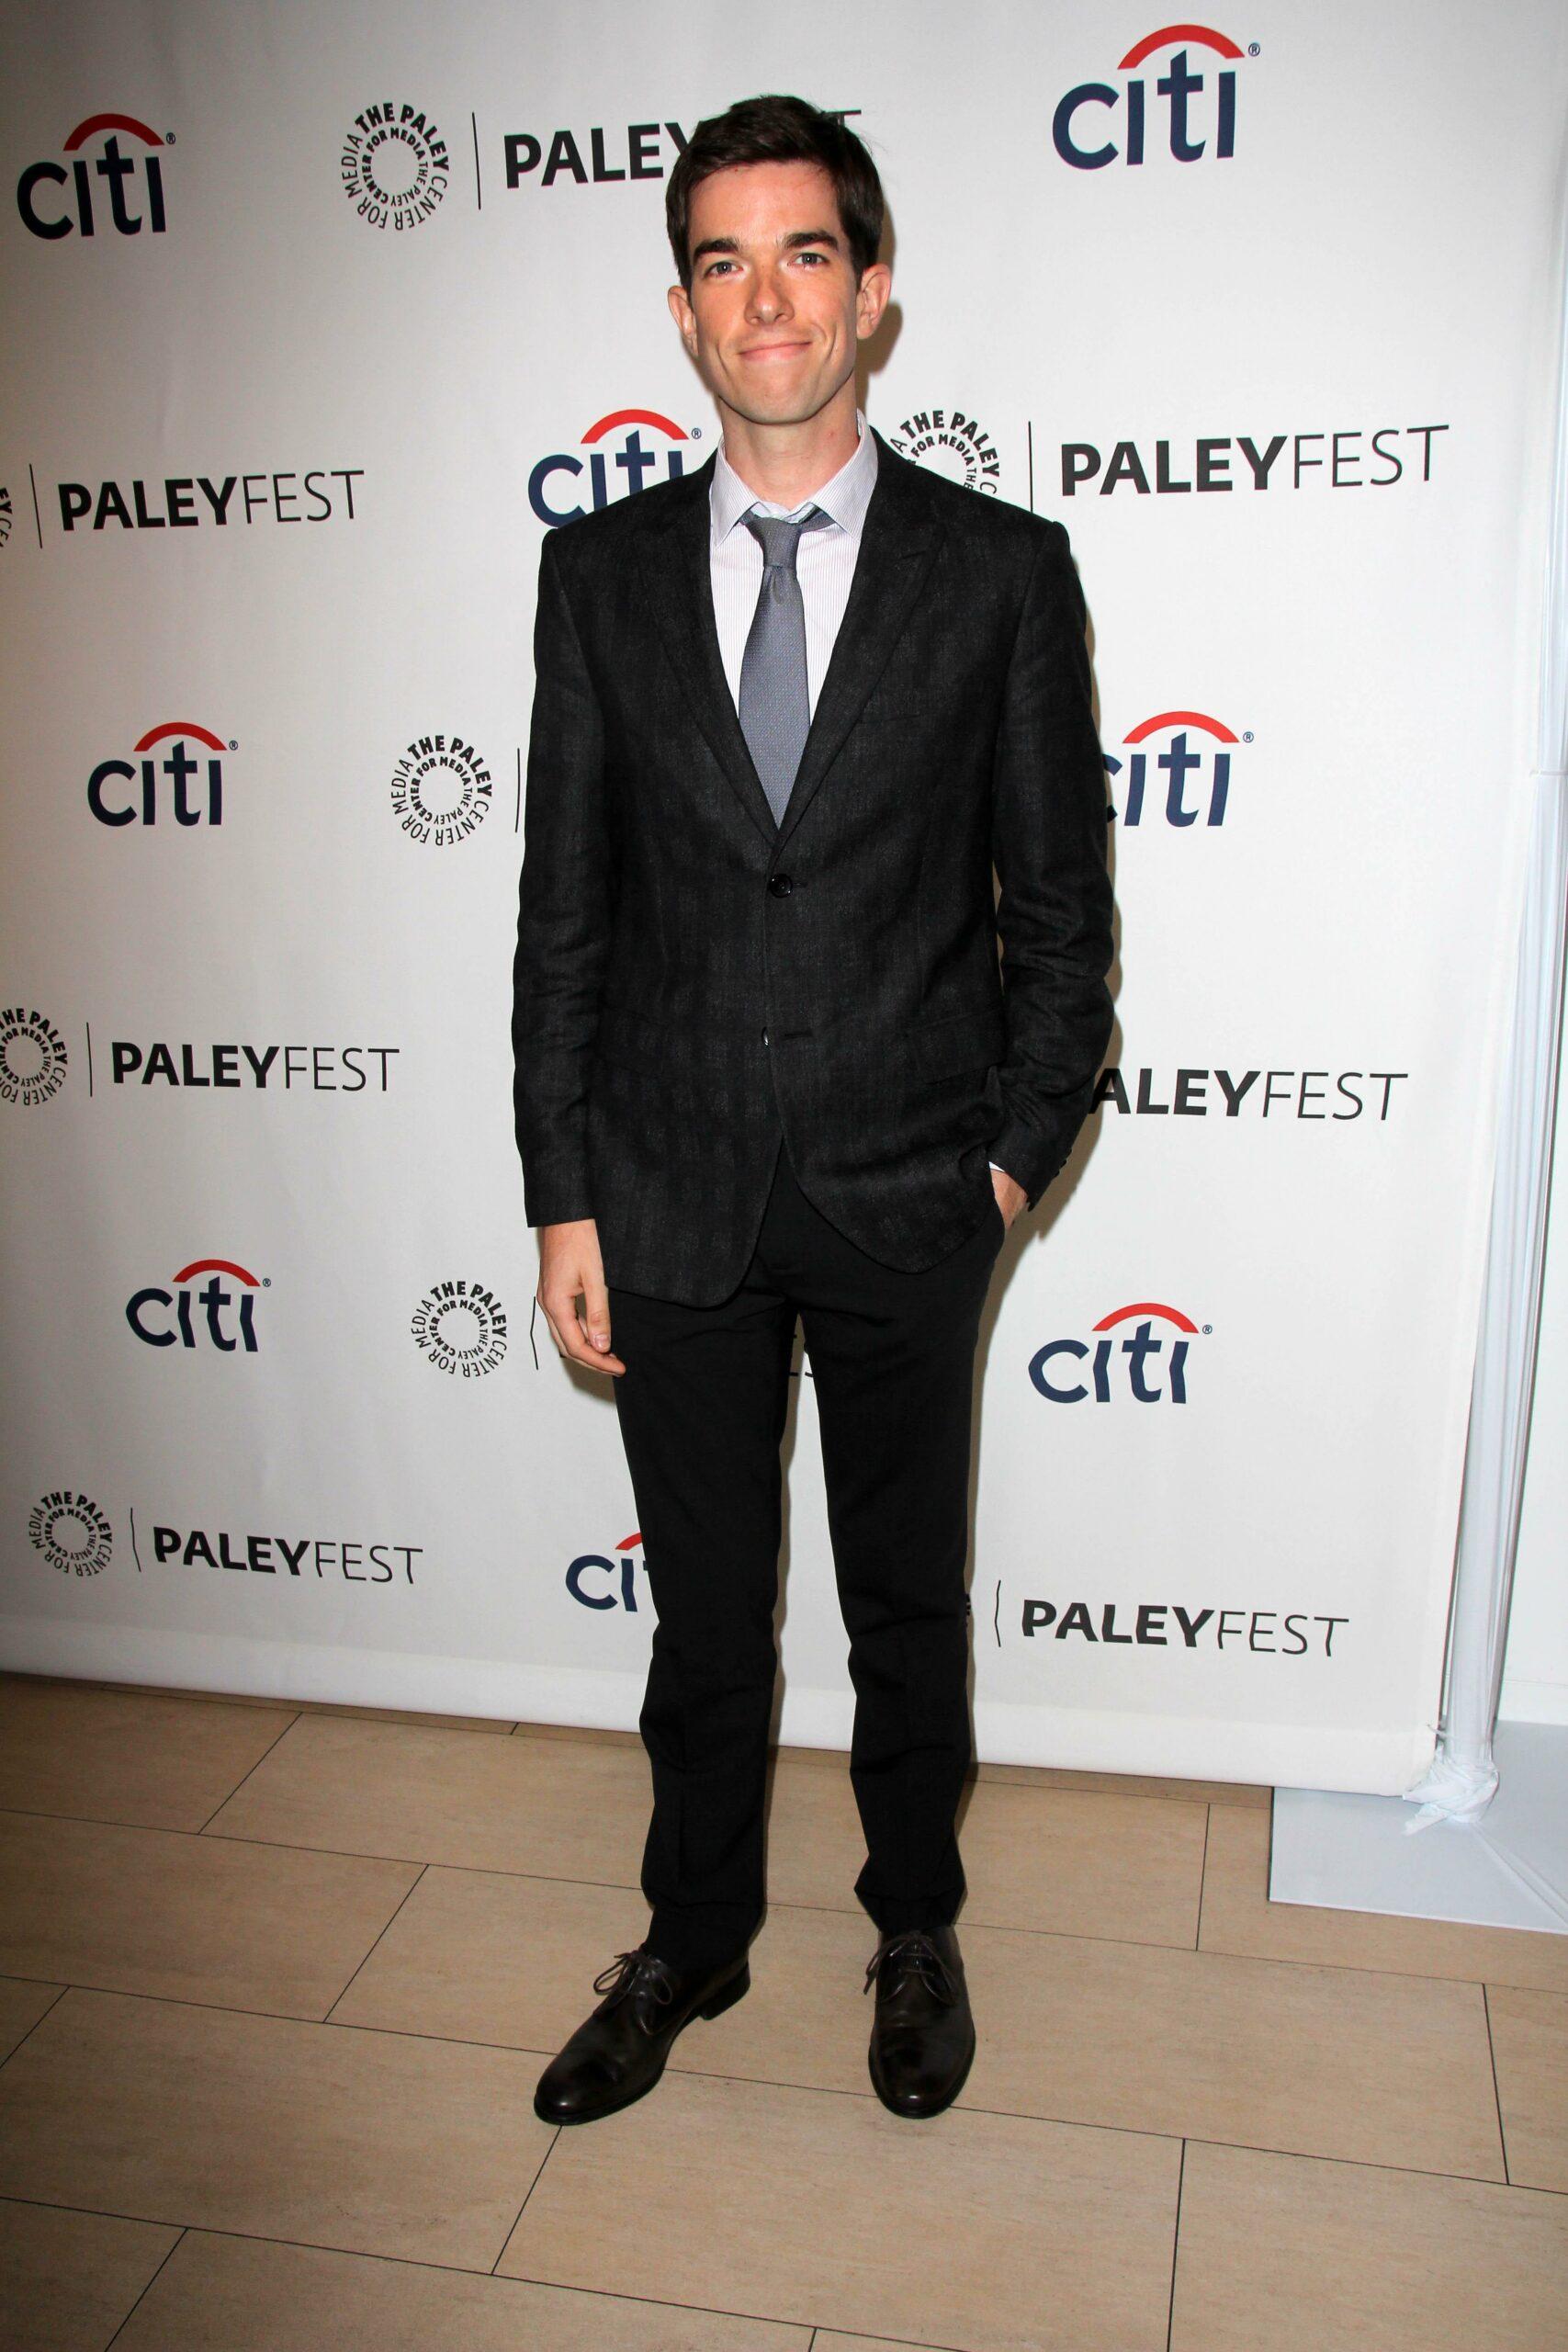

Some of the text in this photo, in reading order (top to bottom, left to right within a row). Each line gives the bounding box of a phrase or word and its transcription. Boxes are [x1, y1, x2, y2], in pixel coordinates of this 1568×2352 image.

[1053, 50, 1235, 169] citi
[17, 135, 166, 240] citi
[341, 103, 449, 231] THE PALEY CENTER FOR MEDIA
[362, 127, 428, 207] THE PALEY CENTER FOR MEDIA
[900, 410, 999, 477] THE PALEY
[911, 436, 935, 458] FOR
[939, 434, 975, 466] MEDIA
[1062, 424, 1450, 496] PALEYFEST
[58, 469, 365, 531] PALEYFEST
[87, 741, 222, 827] citi
[391, 735, 492, 846] THE PALEY CENTER FOR MEDIA
[410, 756, 472, 825] THE PALEY CENTER FOR MEDIA
[1, 1027, 19, 1045] FOR
[21, 1026, 50, 1055] MEDIA
[29, 1011, 68, 1065] PALEY
[41, 1056, 51, 1073] THE
[113, 1042, 400, 1091] PALEYFEST
[20, 1071, 45, 1087] PALEY
[23, 1067, 66, 1106] CENTER
[1090, 1068, 1408, 1121] ALEYFEST
[126, 1276, 258, 1352] citi
[411, 1281, 507, 1377] THE PALEY CENTER FOR MEDIA
[429, 1299, 489, 1360] THE PALEY CENTER FOR MEDIA
[1028, 1321, 1190, 1404] citi
[28, 1491, 112, 1577] THE PALEY CENTER FOR MEDIA
[44, 1508, 96, 1560] THE PALEY CENTER FOR MEDIA
[153, 1526, 423, 1585] PALEYFEST
[566, 1555, 649, 1612] ci
[1022, 1600, 1348, 1657] PALEYFEST
